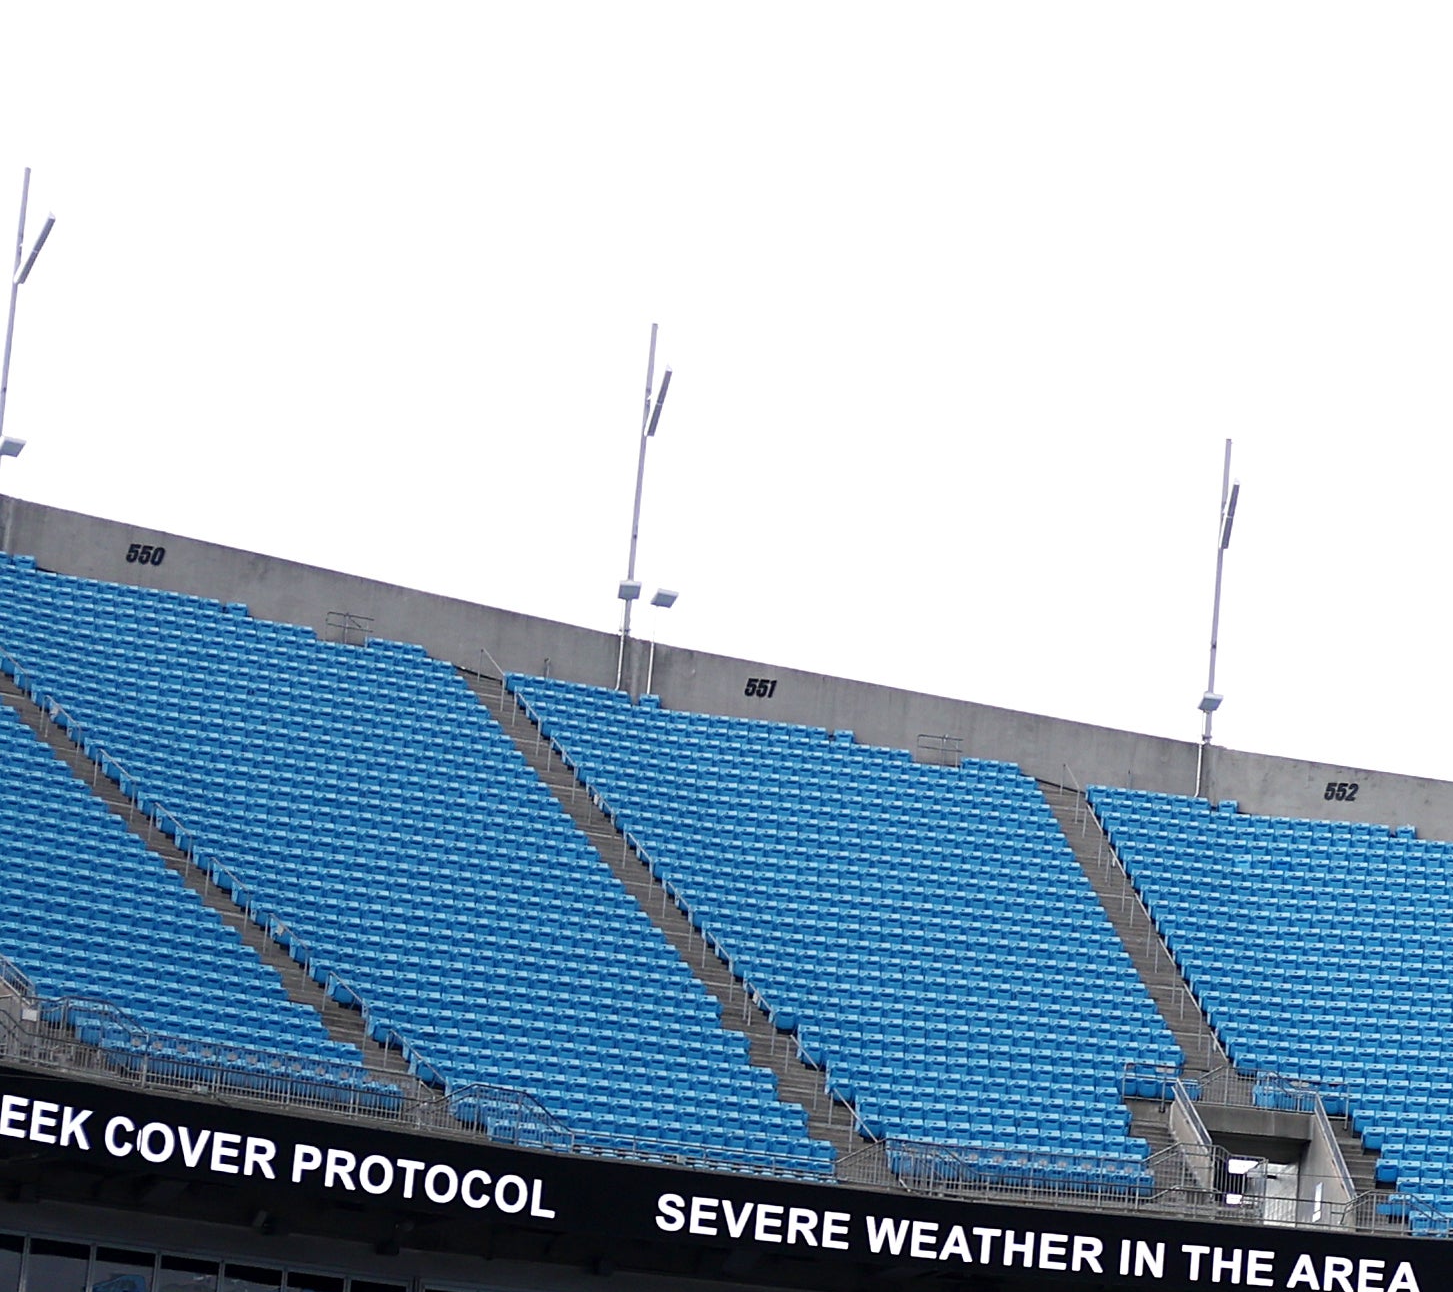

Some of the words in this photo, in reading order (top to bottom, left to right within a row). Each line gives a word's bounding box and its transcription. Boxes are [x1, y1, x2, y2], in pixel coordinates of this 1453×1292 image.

[126, 544, 165, 566] 550
[745, 678, 777, 698] 551
[1324, 783, 1359, 801] 552
[105, 1116, 276, 1179] COVER
[292, 1144, 555, 1218] PROTOCOL
[656, 1194, 850, 1249] SEVERE
[866, 1216, 1103, 1273] WEATHER
[1120, 1240, 1165, 1278] IN
[1182, 1245, 1274, 1286] THE
